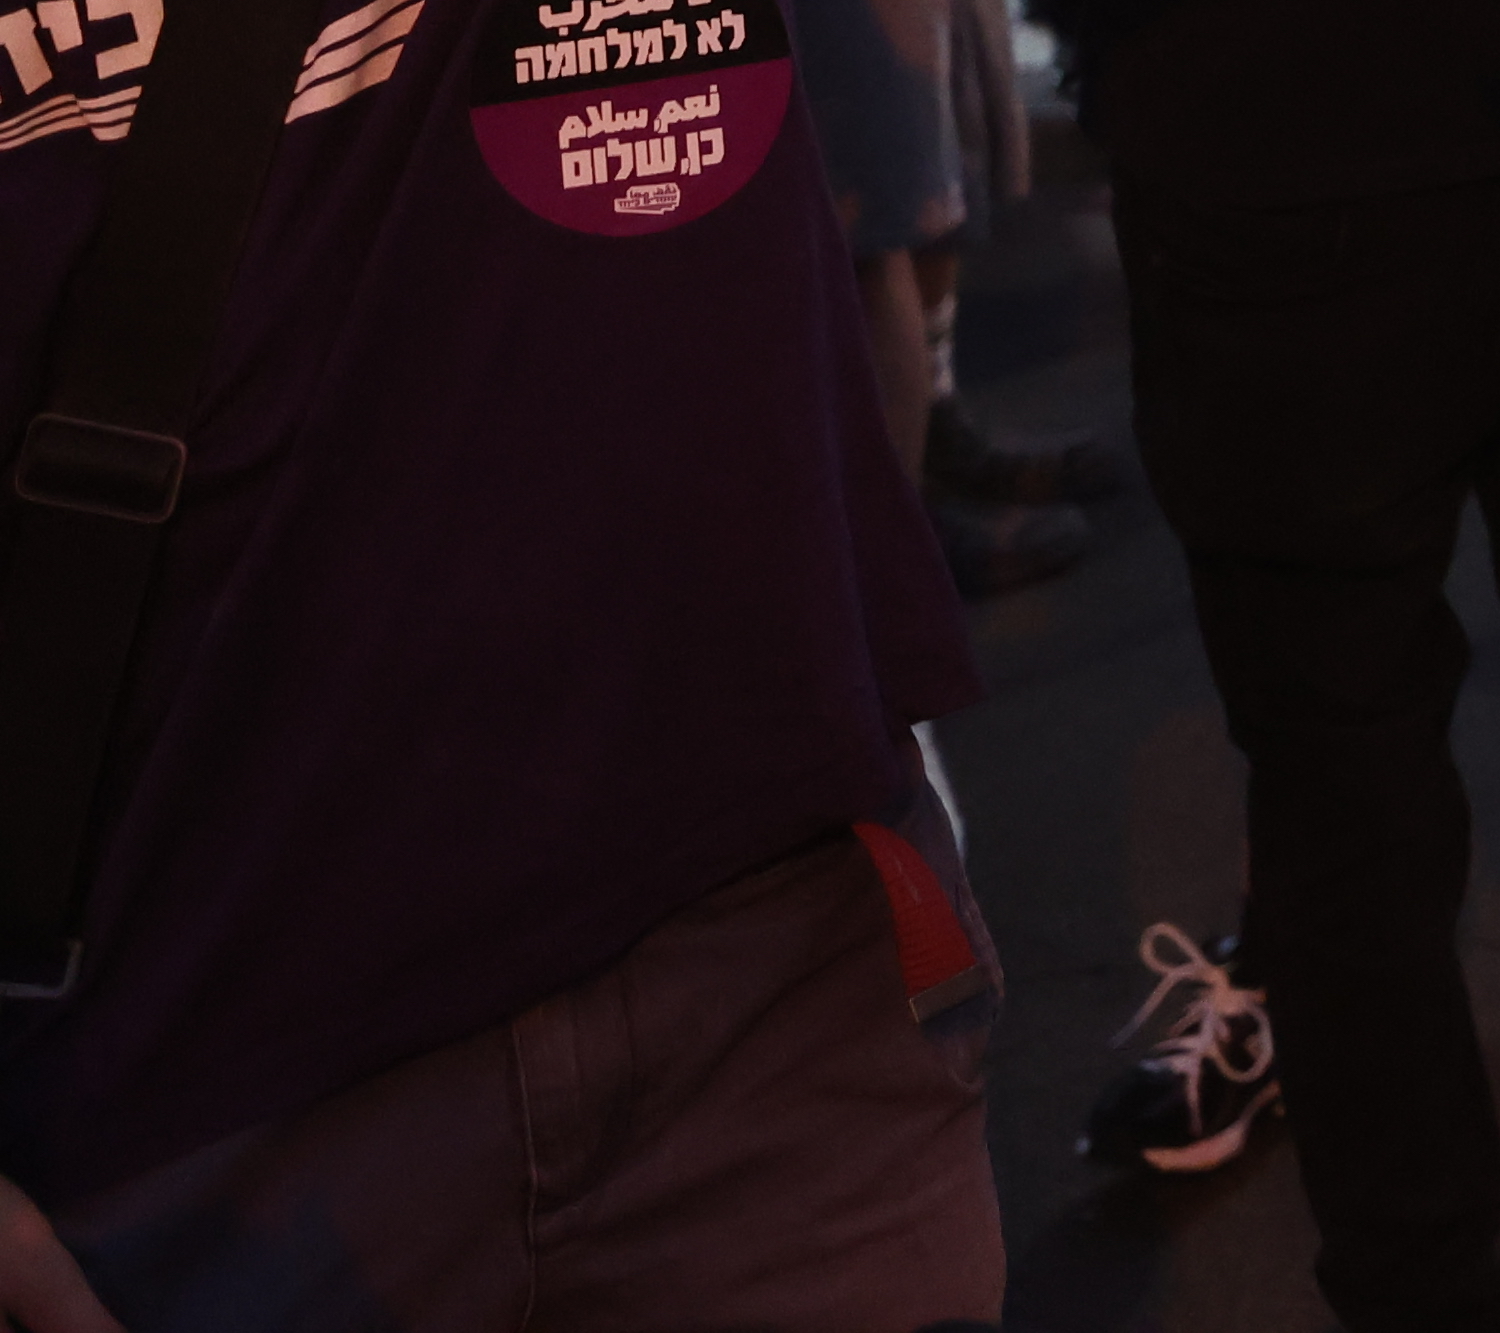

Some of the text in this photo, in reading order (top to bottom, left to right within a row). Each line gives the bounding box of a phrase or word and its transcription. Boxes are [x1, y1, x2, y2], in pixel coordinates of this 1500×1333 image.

[514, 9, 746, 85] לא למלחמה
[558, 100, 649, 150] سلام
[561, 136, 677, 190] שלום
